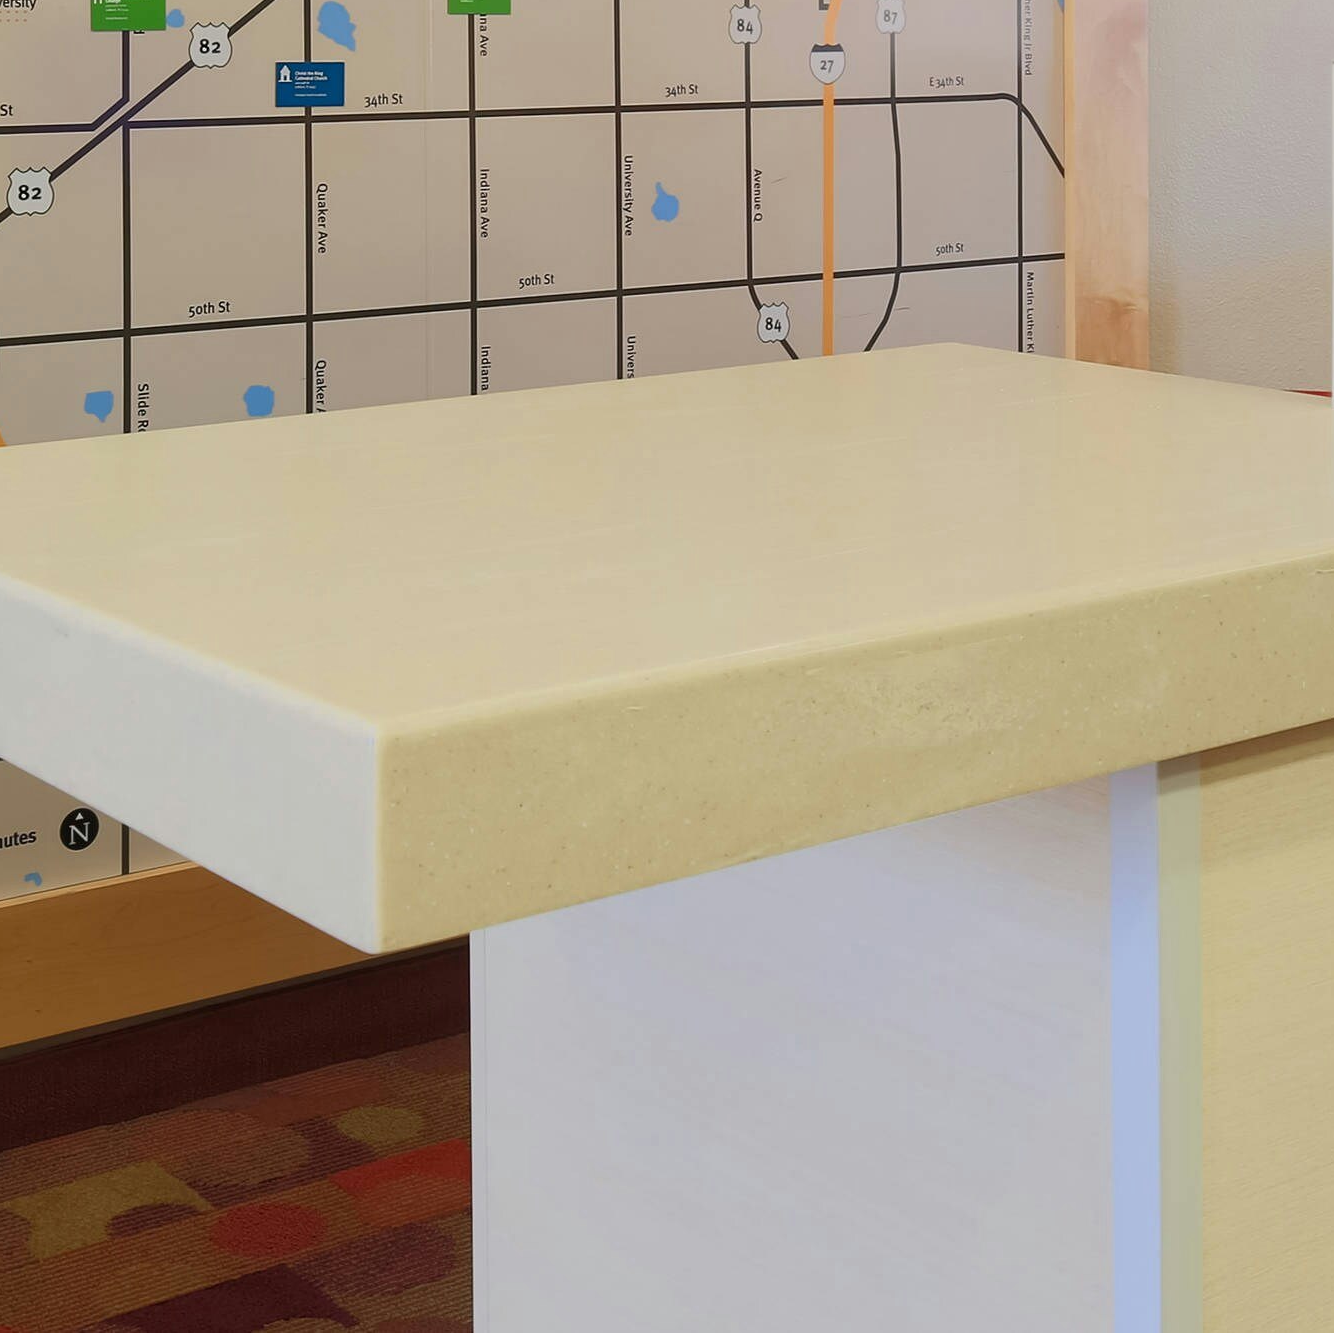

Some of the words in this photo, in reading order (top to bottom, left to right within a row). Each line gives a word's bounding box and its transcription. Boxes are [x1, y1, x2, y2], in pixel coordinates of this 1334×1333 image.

[737, 19, 753, 34] 84
[200, 39, 220, 53] 82
[820, 60, 833, 72] 27
[365, 94, 388, 107] 34th
[392, 94, 402, 104] St
[624, 156, 633, 212] University
[754, 169, 762, 209] Avenue
[19, 185, 41, 200] 82
[754, 213, 762, 222] Q
[625, 217, 633, 235] Ave
[189, 302, 213, 318] 50th
[219, 301, 230, 313] St
[766, 317, 781, 332] 84
